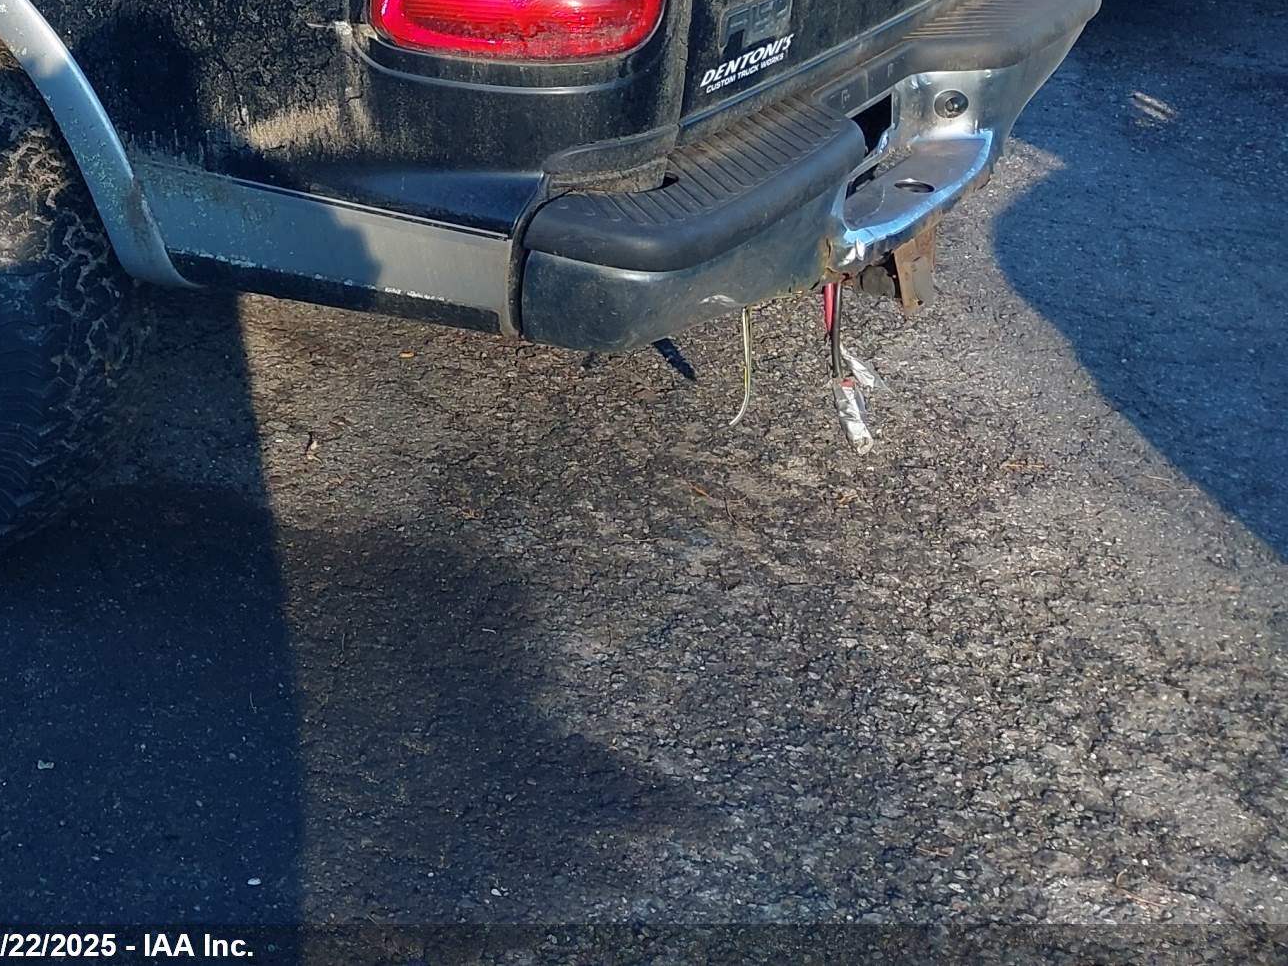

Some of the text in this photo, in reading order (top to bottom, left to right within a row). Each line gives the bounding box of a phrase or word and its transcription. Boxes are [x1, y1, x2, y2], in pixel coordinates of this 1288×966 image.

[700, 34, 794, 87] DENTONI'S
[706, 52, 785, 94] CUSTOM TRUCK WORKS
